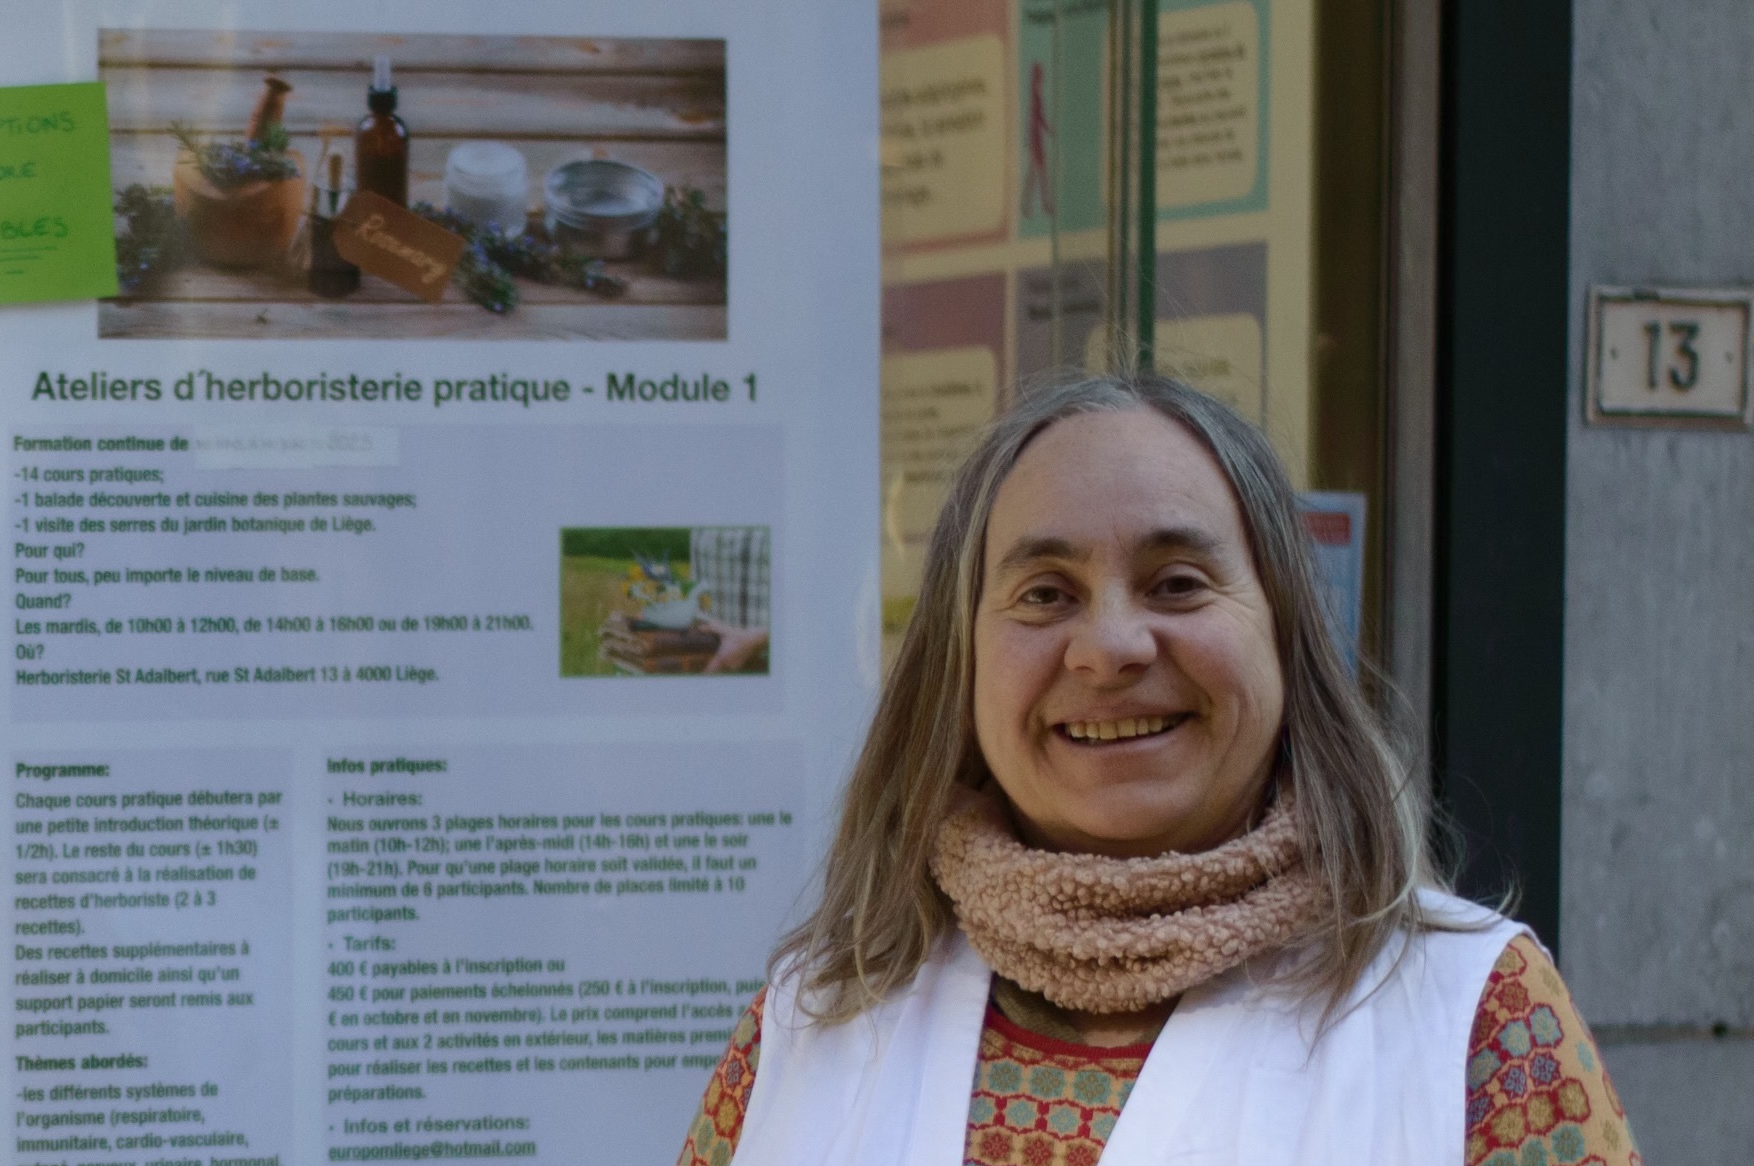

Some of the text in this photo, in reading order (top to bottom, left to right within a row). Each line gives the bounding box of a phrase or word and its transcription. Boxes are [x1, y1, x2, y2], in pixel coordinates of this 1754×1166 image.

[1643, 320, 1700, 393] 13
[32, 372, 162, 400] Ateliers
[173, 372, 422, 400] d´herboristerie
[433, 375, 570, 405] pratique
[606, 373, 730, 400] Module
[743, 373, 756, 400] 1
[13, 436, 92, 450] Formation
[97, 436, 166, 450] continue
[169, 436, 188, 450] de
[42, 469, 84, 481] cours
[34, 492, 84, 507] balade
[88, 492, 171, 506] découverte
[175, 492, 190, 506] et
[193, 492, 248, 506] cuisine
[252, 492, 279, 506] des
[282, 492, 338, 507] plantes
[35, 517, 74, 532] visite
[78, 518, 105, 532] des
[110, 519, 155, 532] serres
[160, 517, 179, 531] du
[183, 516, 226, 533] jardin
[231, 517, 304, 532] botanique
[310, 516, 327, 531] de
[14, 542, 84, 559] Pour qui?
[14, 567, 48, 583] Pour
[92, 570, 121, 584] peu
[124, 568, 182, 583] importe
[186, 567, 200, 582] le
[204, 568, 254, 582] niveau
[257, 567, 276, 581] de
[14, 593, 71, 609] Quand?
[15, 619, 41, 634] Les
[105, 618, 122, 633] de
[243, 617, 261, 632] de
[378, 619, 396, 631] ou
[400, 616, 418, 630] de
[14, 643, 44, 659] Où?
[16, 670, 111, 684] Herboristerie
[115, 668, 131, 684] St
[205, 670, 230, 682] rue
[233, 667, 249, 682] St
[253, 667, 315, 682] Adalbert
[15, 763, 109, 779] Programme:
[327, 758, 446, 774] Infos pratiques:
[15, 1056, 76, 1070] Thèmes
[17, 1081, 218, 1101] -les différents systèmes de
[16, 1112, 105, 1128] l'organisme
[344, 1119, 388, 1133] Infos
[393, 1118, 411, 1132] et
